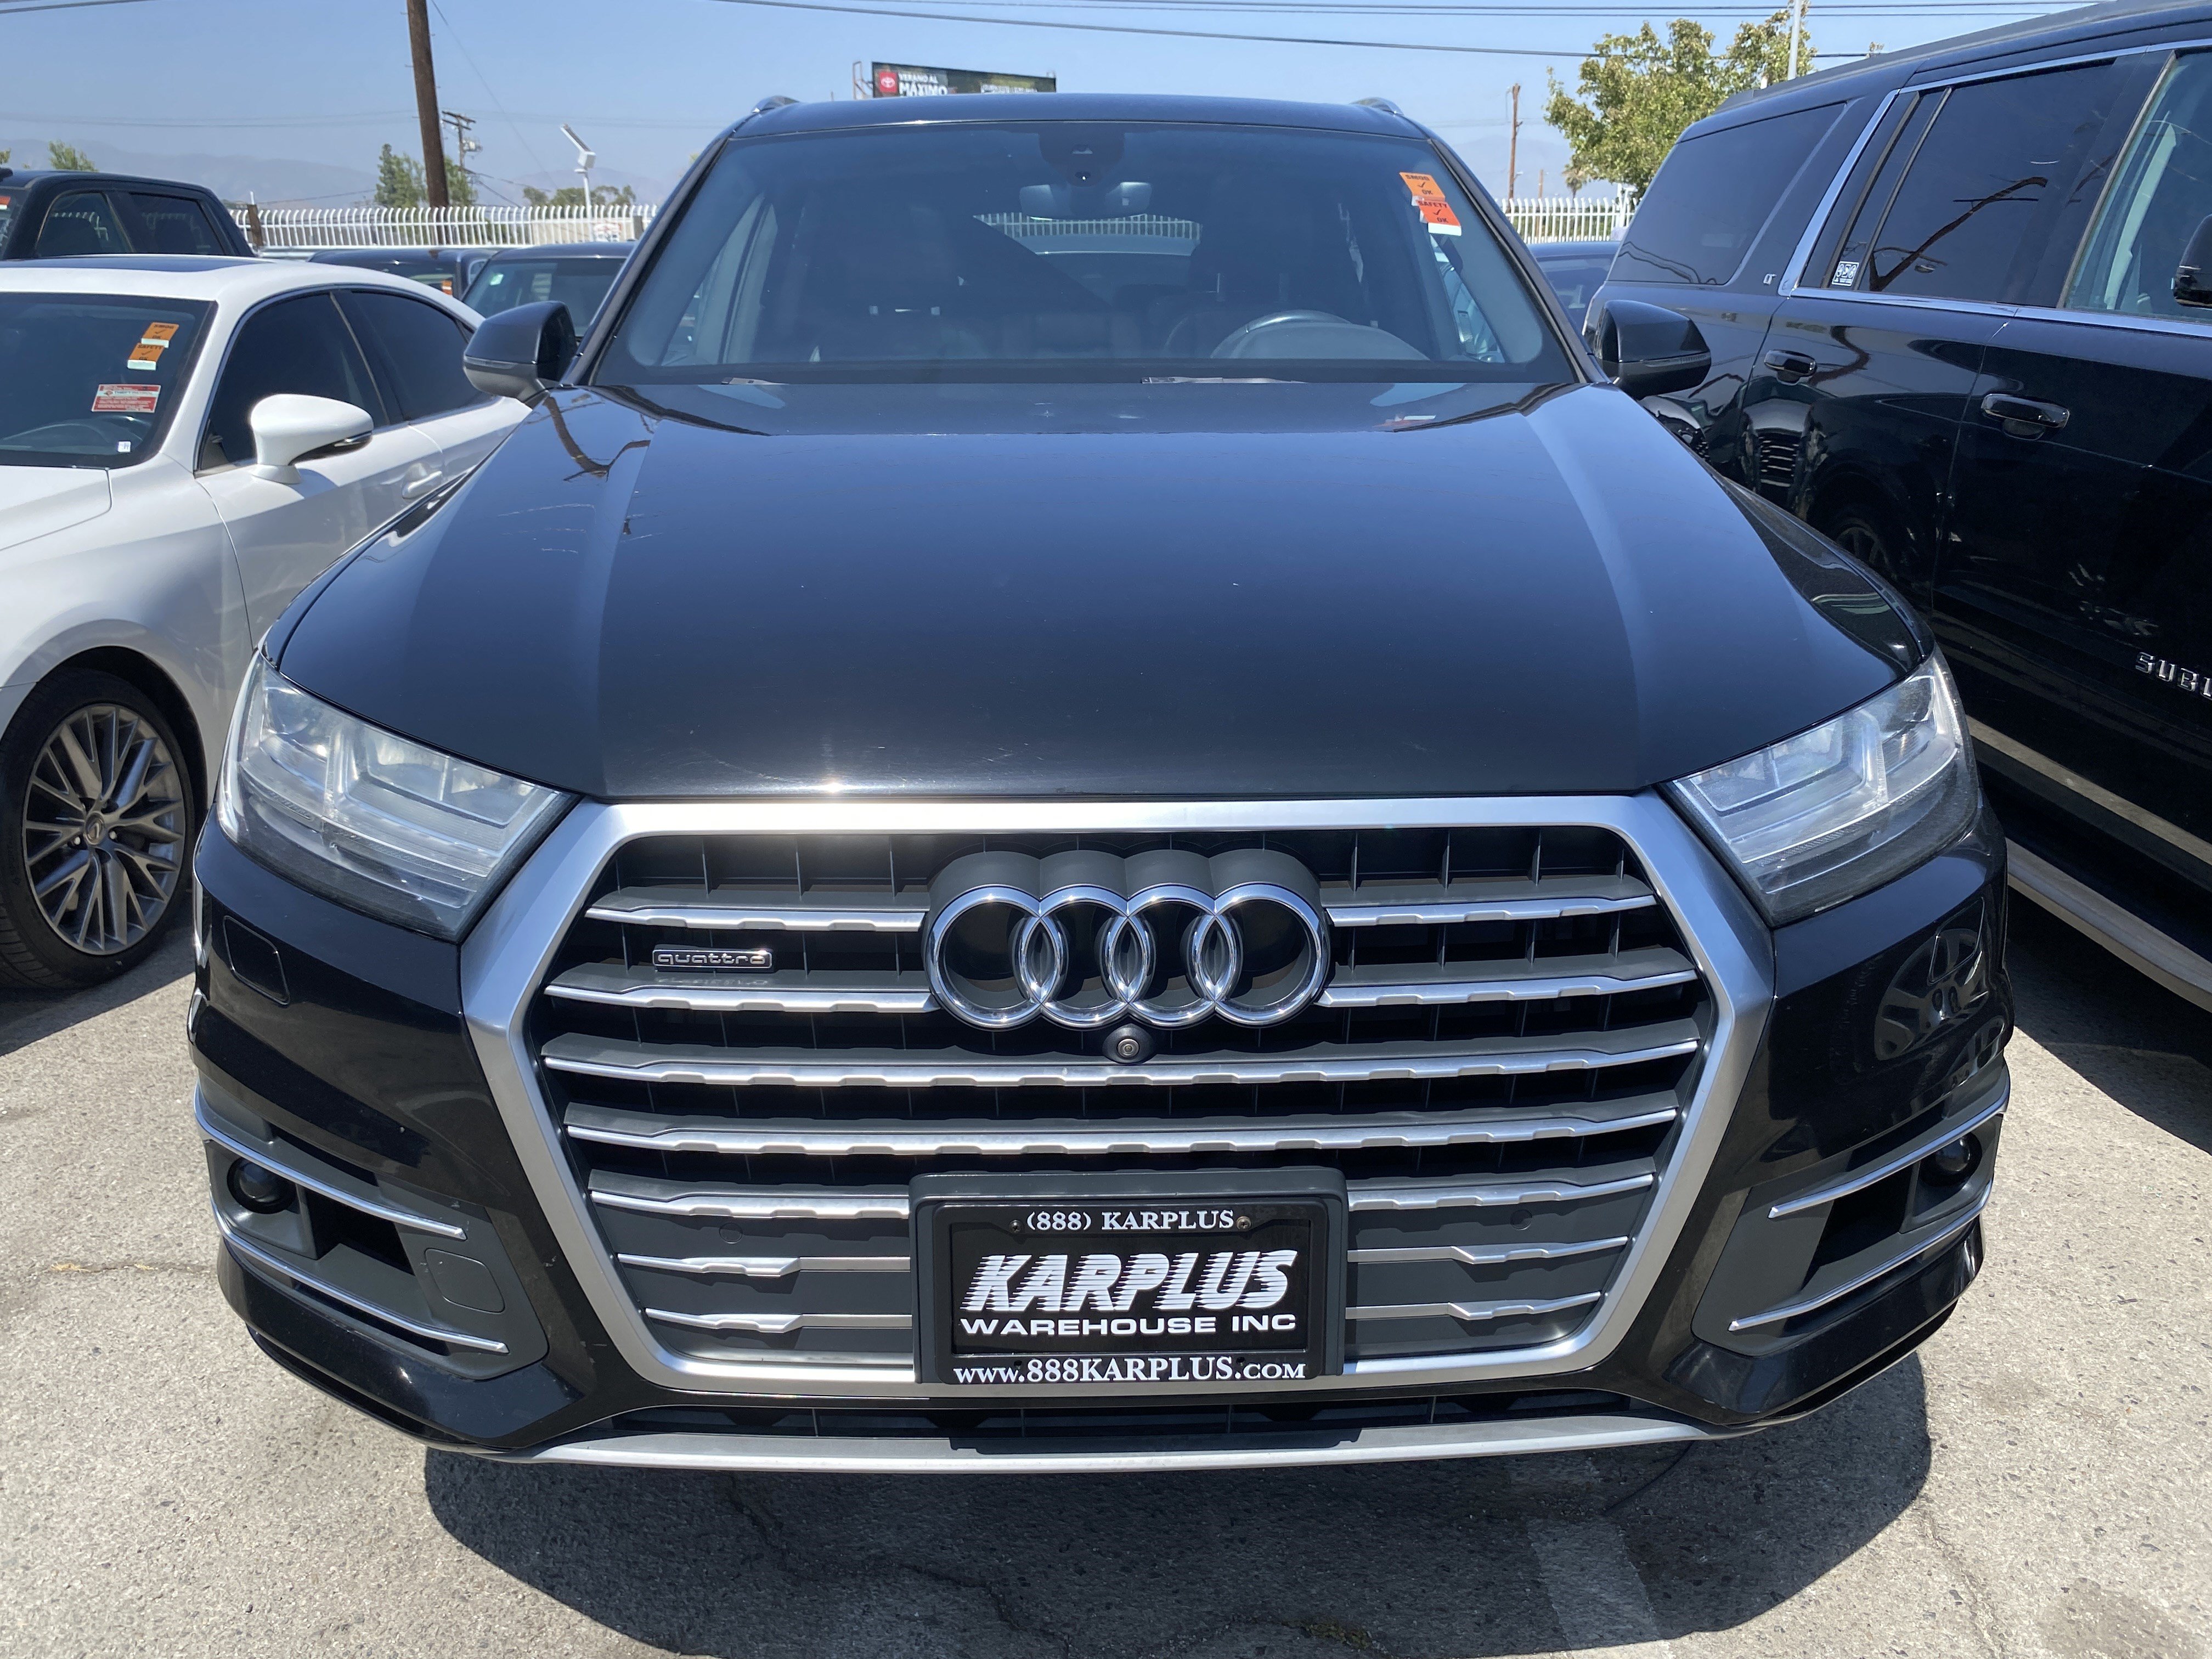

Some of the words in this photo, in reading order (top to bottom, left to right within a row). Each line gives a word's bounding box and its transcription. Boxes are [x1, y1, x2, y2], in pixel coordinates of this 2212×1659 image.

[658, 953, 766, 965] quattro
[1027, 1211, 1092, 1231] (888)
[1101, 1210, 1234, 1231] KARPLUS
[960, 1249, 1298, 1312] KARPLUS
[960, 1317, 1216, 1336] WAREHOUSE
[1232, 1314, 1296, 1331] INC
